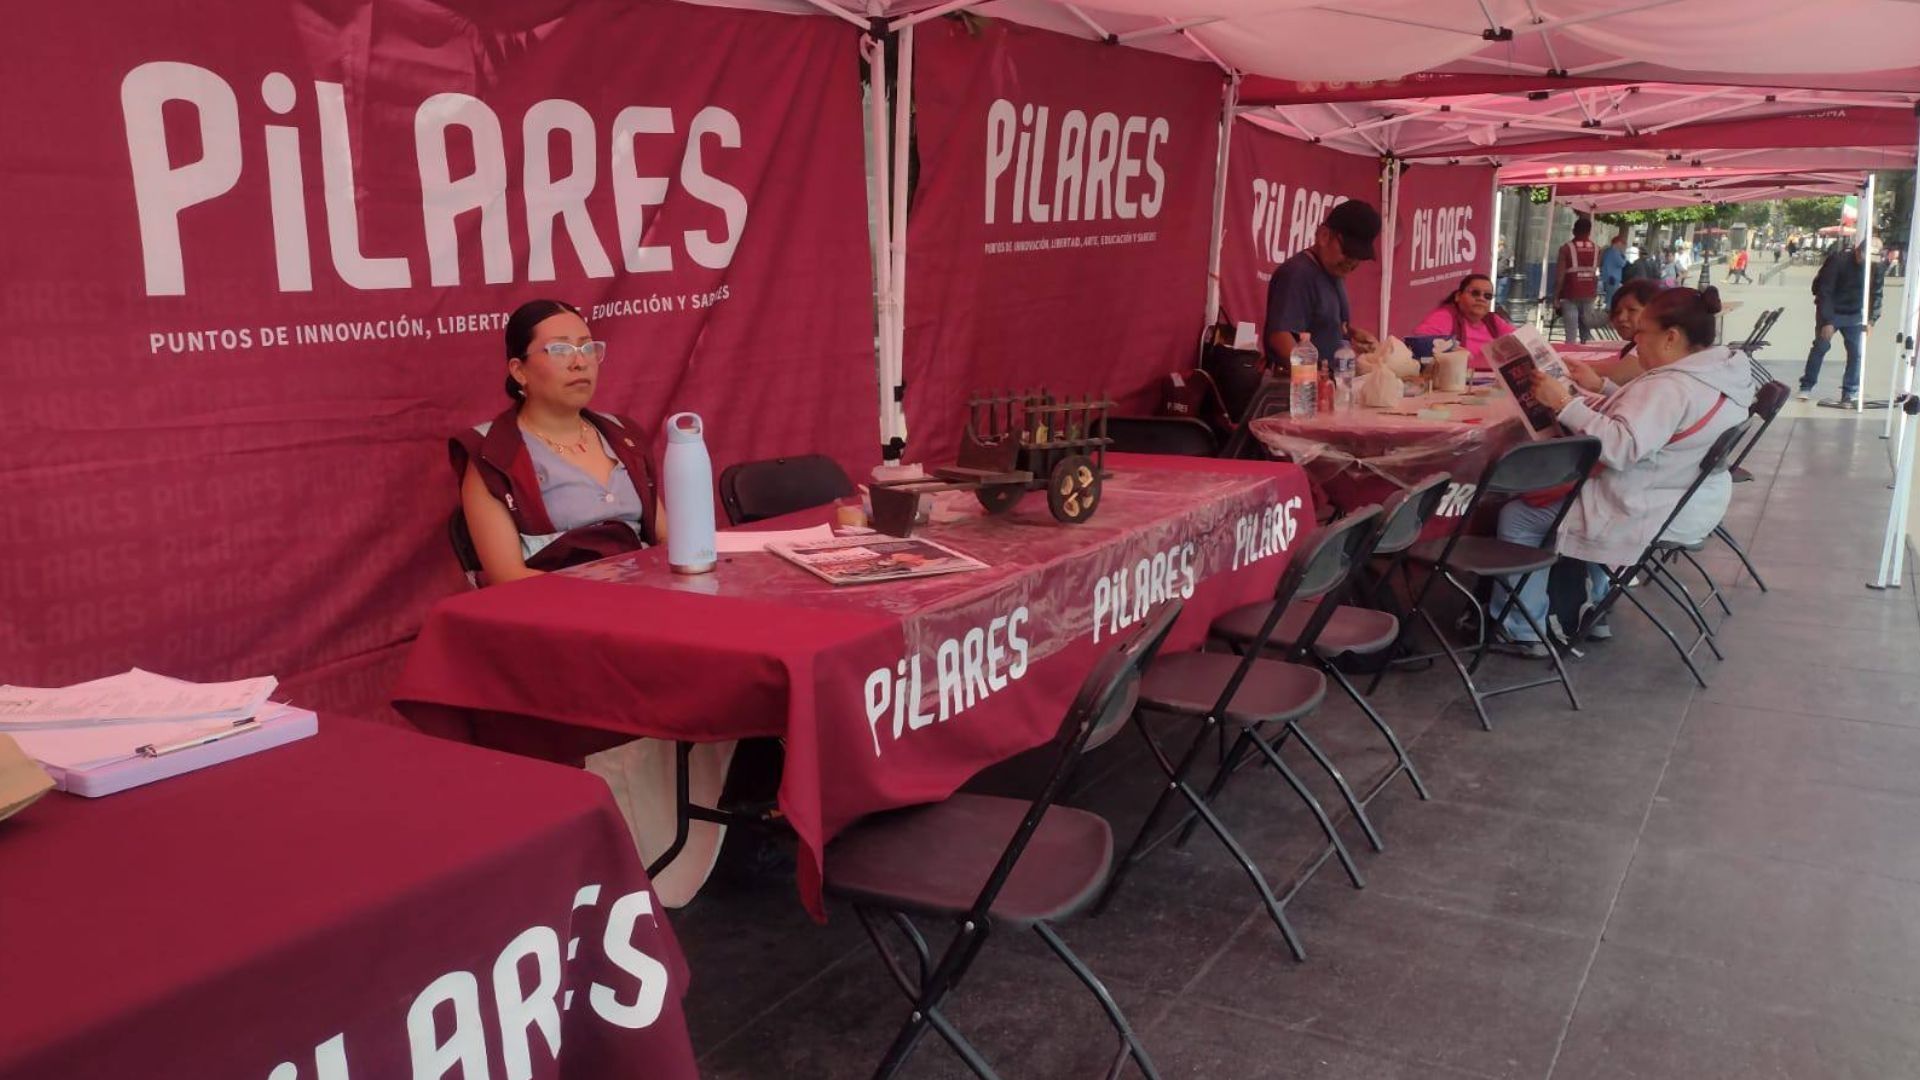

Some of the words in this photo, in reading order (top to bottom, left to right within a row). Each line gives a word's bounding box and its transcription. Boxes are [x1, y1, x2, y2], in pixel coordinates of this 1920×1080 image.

[149, 328, 252, 354] PUNTOS
[259, 325, 290, 347] DE
[295, 313, 433, 345] INNOVACIÓN,
[436, 312, 511, 334] LIBERTA
[591, 293, 673, 320] EDUCACIÓN
[677, 295, 687, 311] Y
